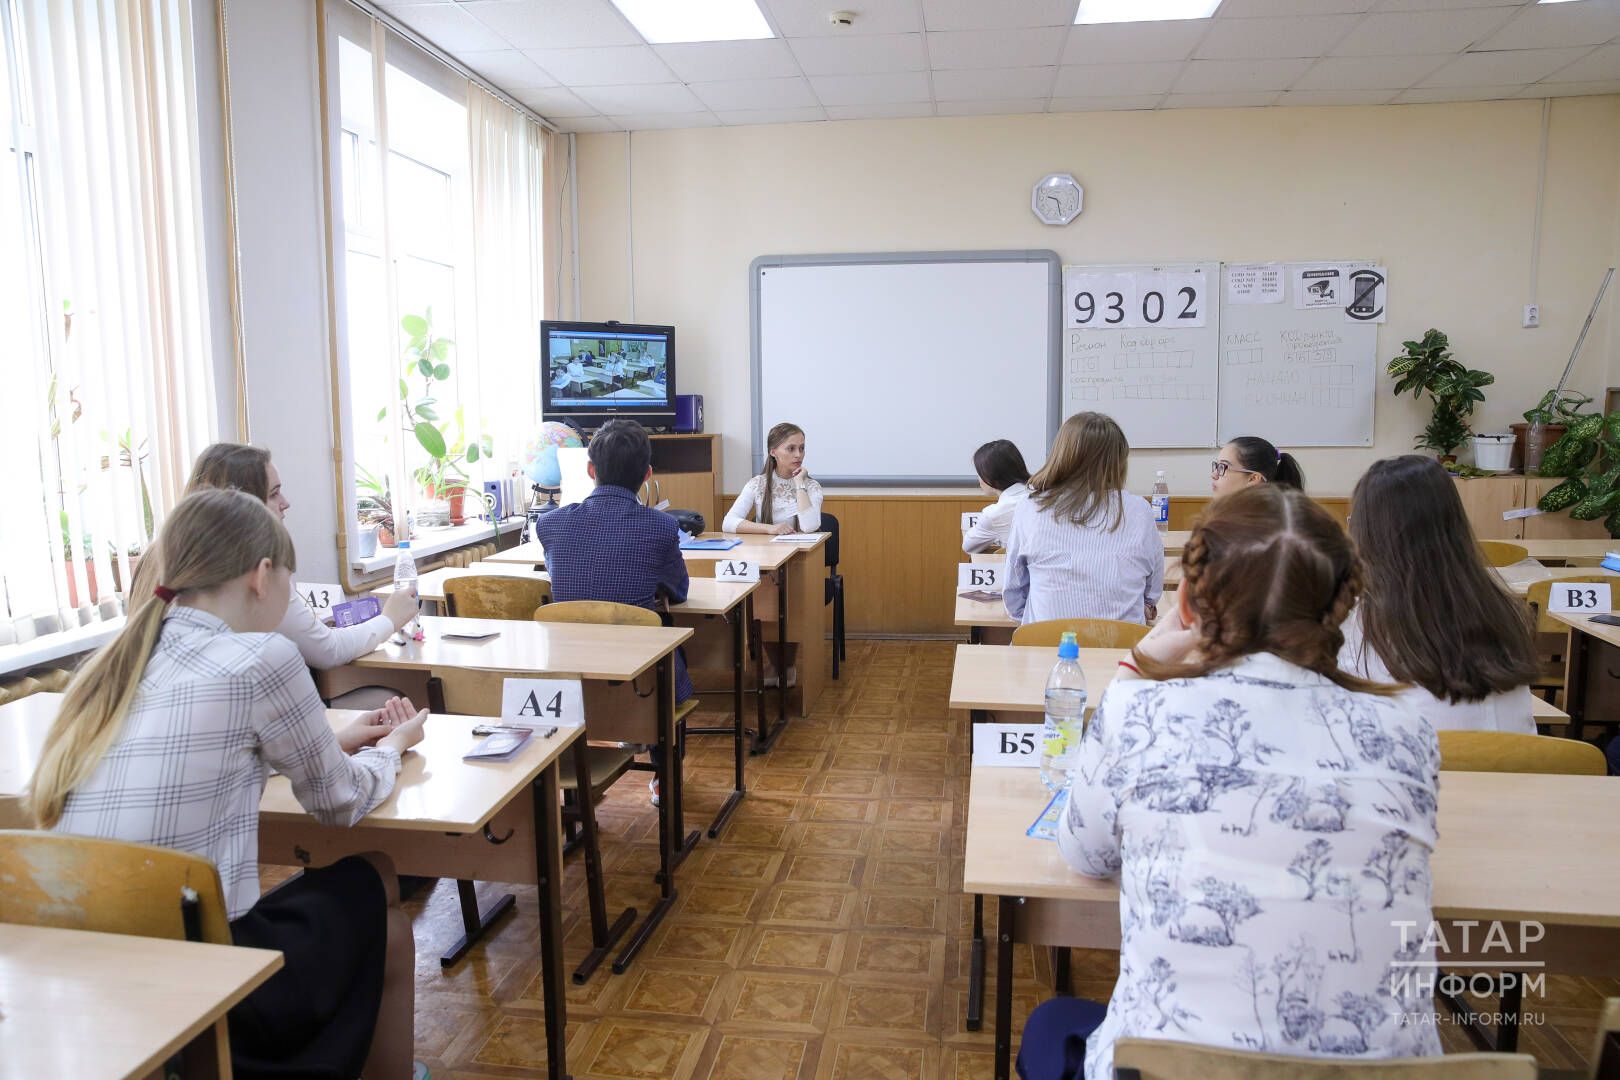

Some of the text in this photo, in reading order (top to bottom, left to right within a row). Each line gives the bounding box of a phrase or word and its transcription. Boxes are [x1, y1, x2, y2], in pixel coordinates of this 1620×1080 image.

[723, 561, 748, 576] А2
[970, 569, 995, 586] Б3
[304, 589, 329, 608] А3
[1567, 589, 1598, 608] В3
[518, 689, 562, 718] А4
[999, 732, 1035, 755] Б5
